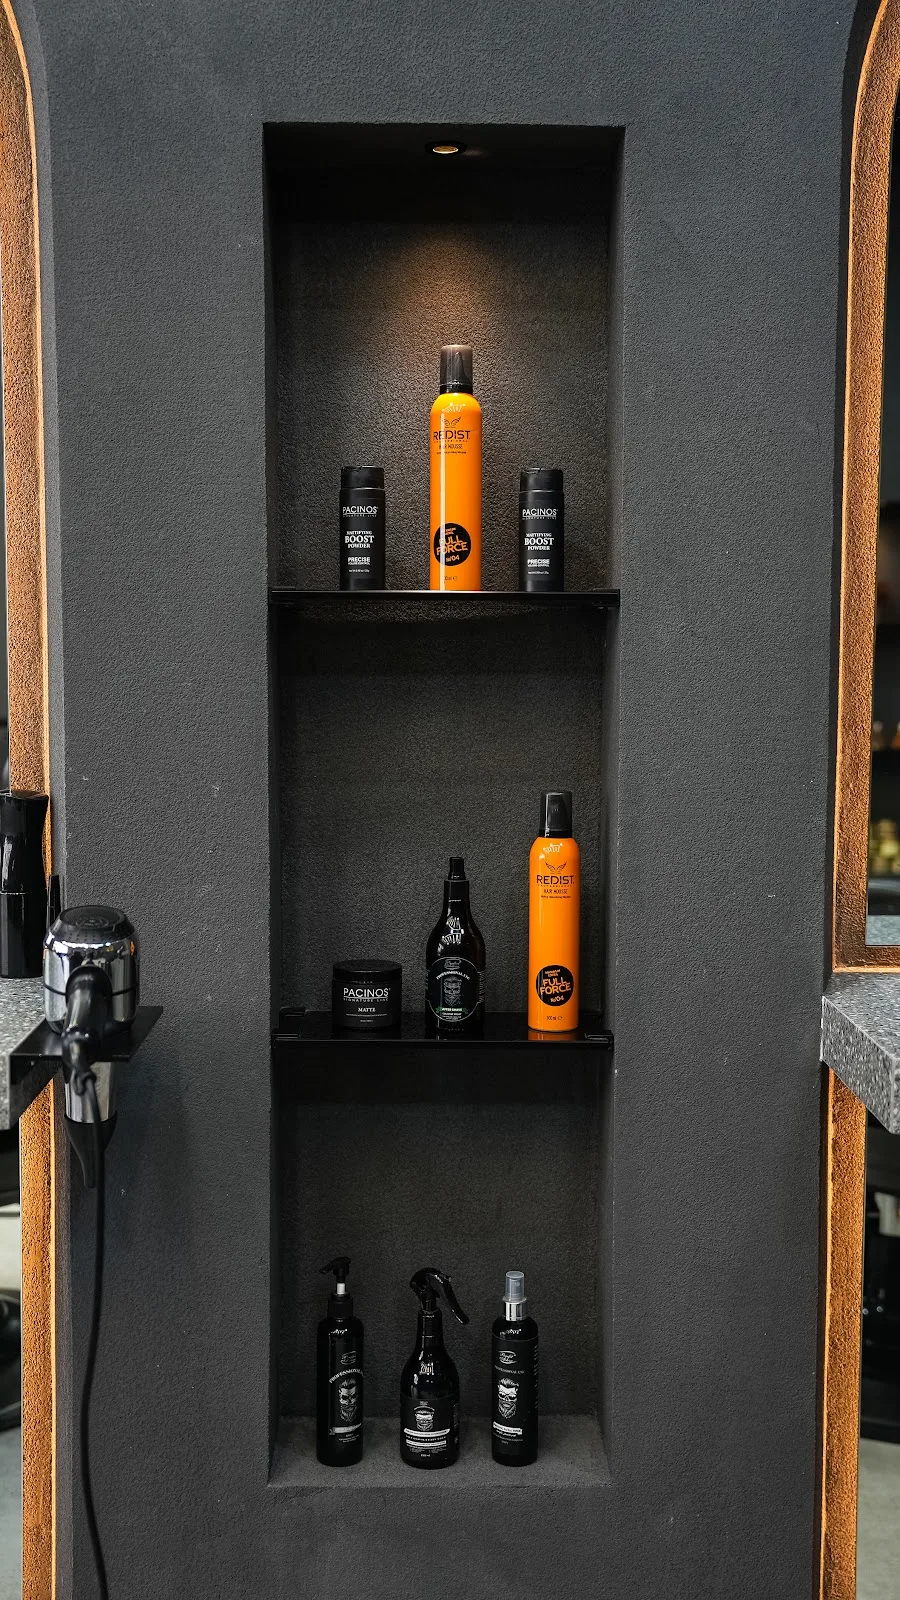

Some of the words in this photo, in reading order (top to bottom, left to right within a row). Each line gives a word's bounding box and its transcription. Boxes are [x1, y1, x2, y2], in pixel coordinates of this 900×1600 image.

[434, 430, 470, 440] REDIST
[342, 505, 378, 514] PACINOS
[344, 535, 374, 543] BOOST
[438, 535, 464, 545] FULL
[436, 542, 468, 556] FORCE
[536, 874, 574, 884] REDIST
[542, 977, 567, 986] FULL
[343, 988, 389, 997] PACINOS
[540, 982, 572, 995] FORCE
